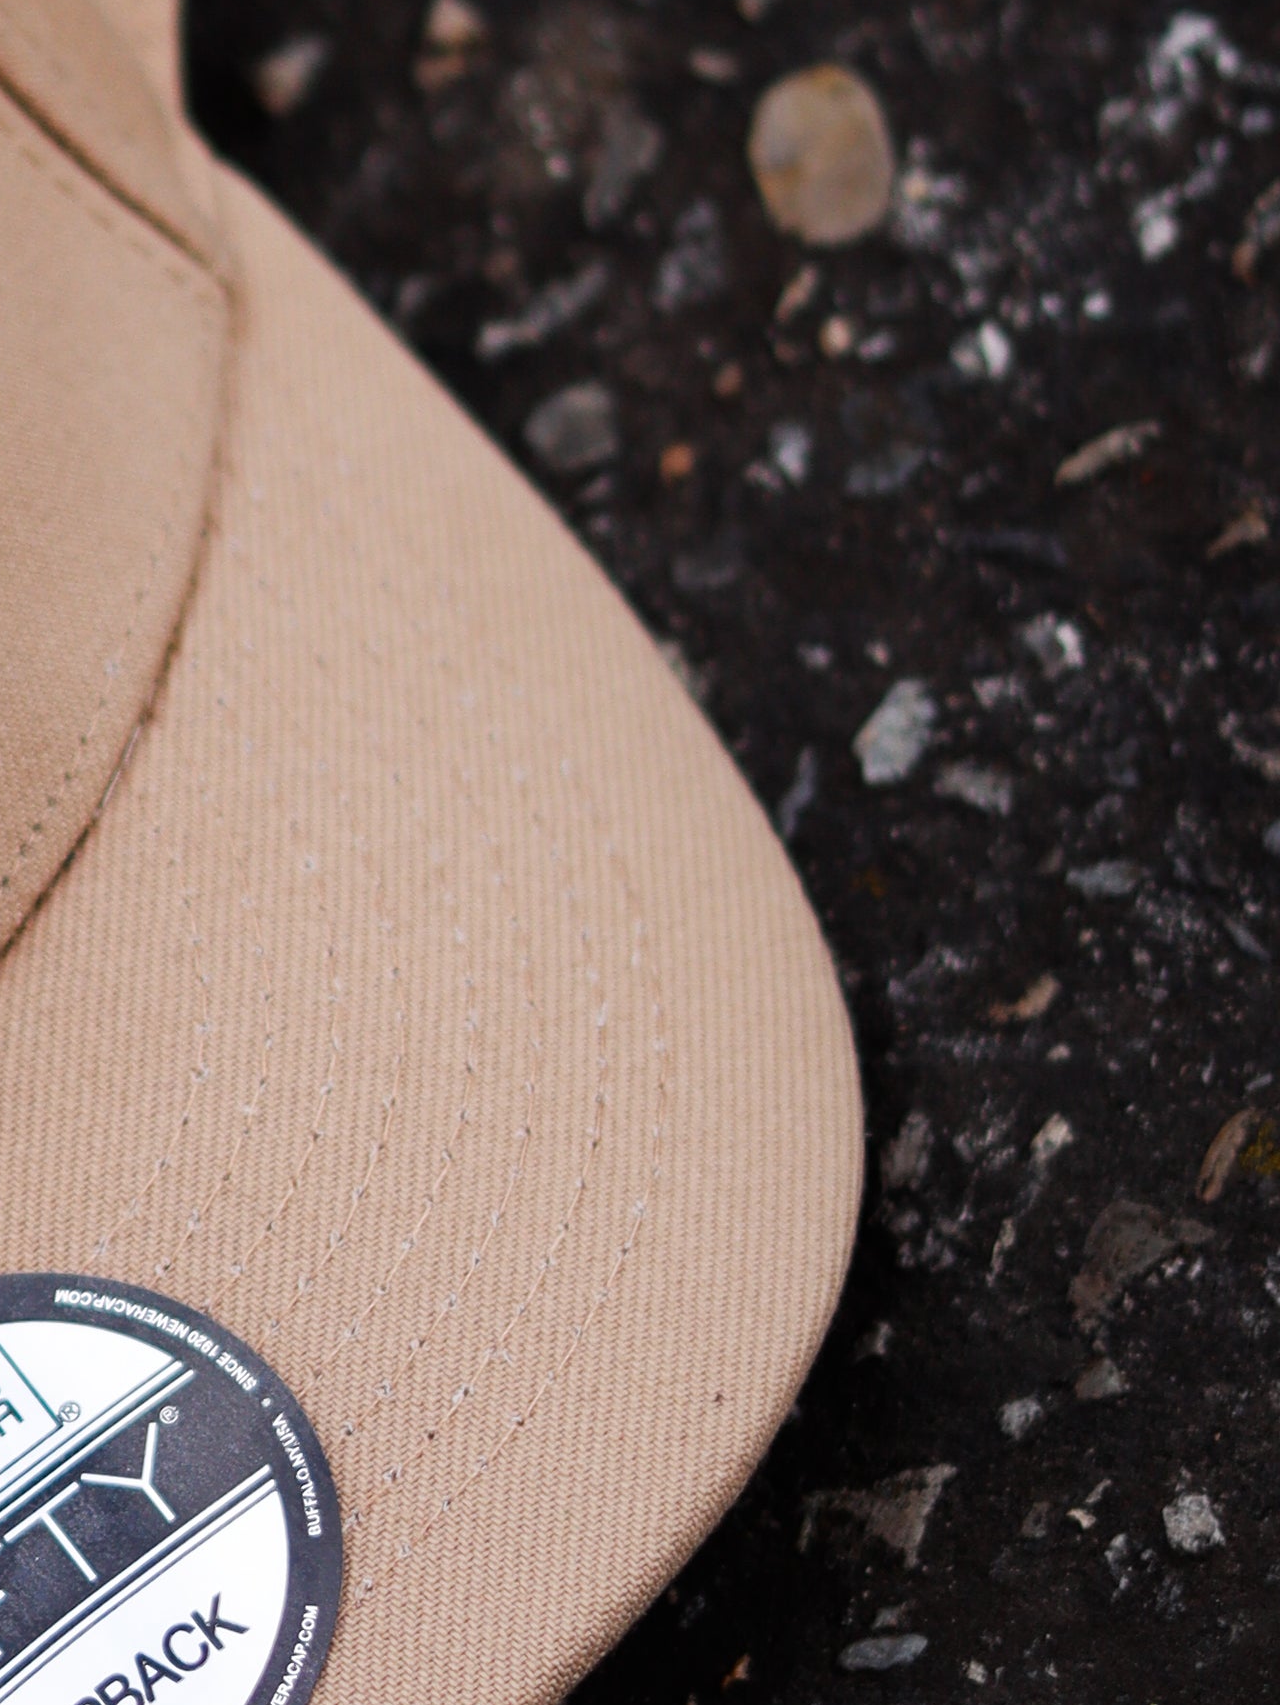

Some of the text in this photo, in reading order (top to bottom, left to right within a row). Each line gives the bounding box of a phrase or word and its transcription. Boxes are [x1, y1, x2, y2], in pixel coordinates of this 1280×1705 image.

[53, 1288, 191, 1337] NEWERACAP.COM
[187, 1330, 220, 1358] 1920
[216, 1351, 258, 1391] SINCE
